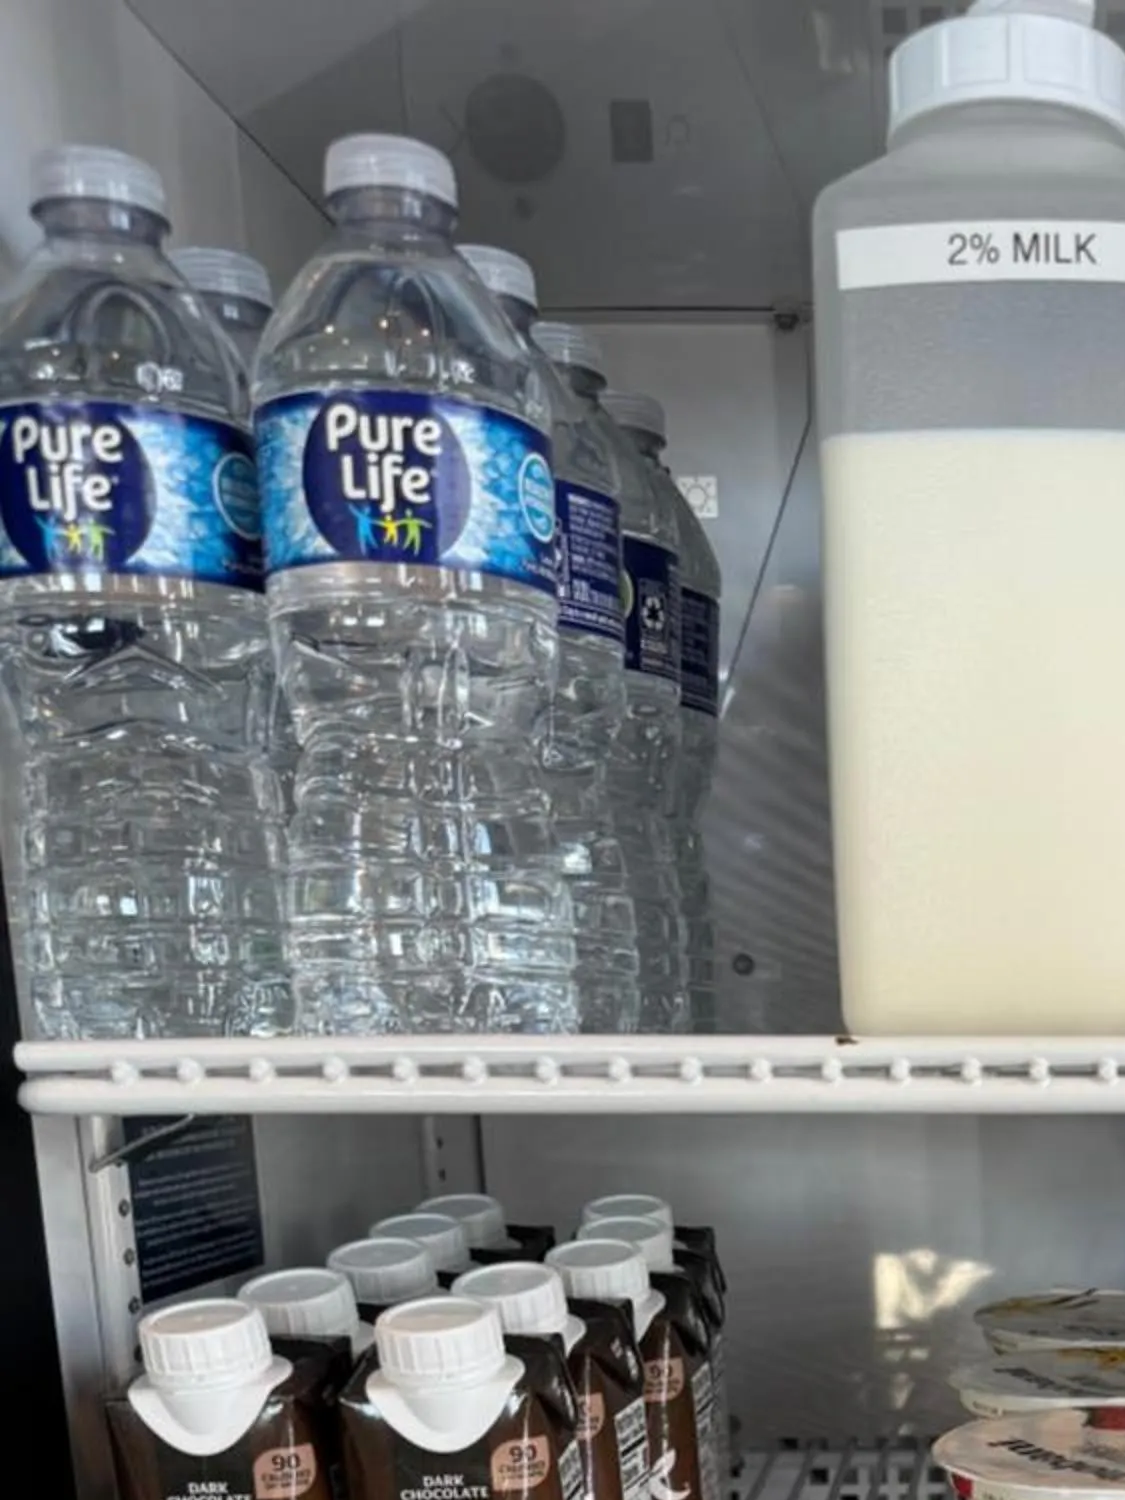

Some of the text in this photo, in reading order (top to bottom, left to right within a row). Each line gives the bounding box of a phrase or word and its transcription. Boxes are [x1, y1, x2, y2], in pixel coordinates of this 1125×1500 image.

[946, 233, 1097, 267] 2% MILK
[12, 415, 123, 464] Pure
[326, 402, 443, 456] Pure
[26, 462, 113, 520] Life
[341, 452, 431, 512] Life
[270, 1453, 301, 1472] 90
[422, 1473, 465, 1488] DARK
[187, 1480, 229, 1495] DARK
